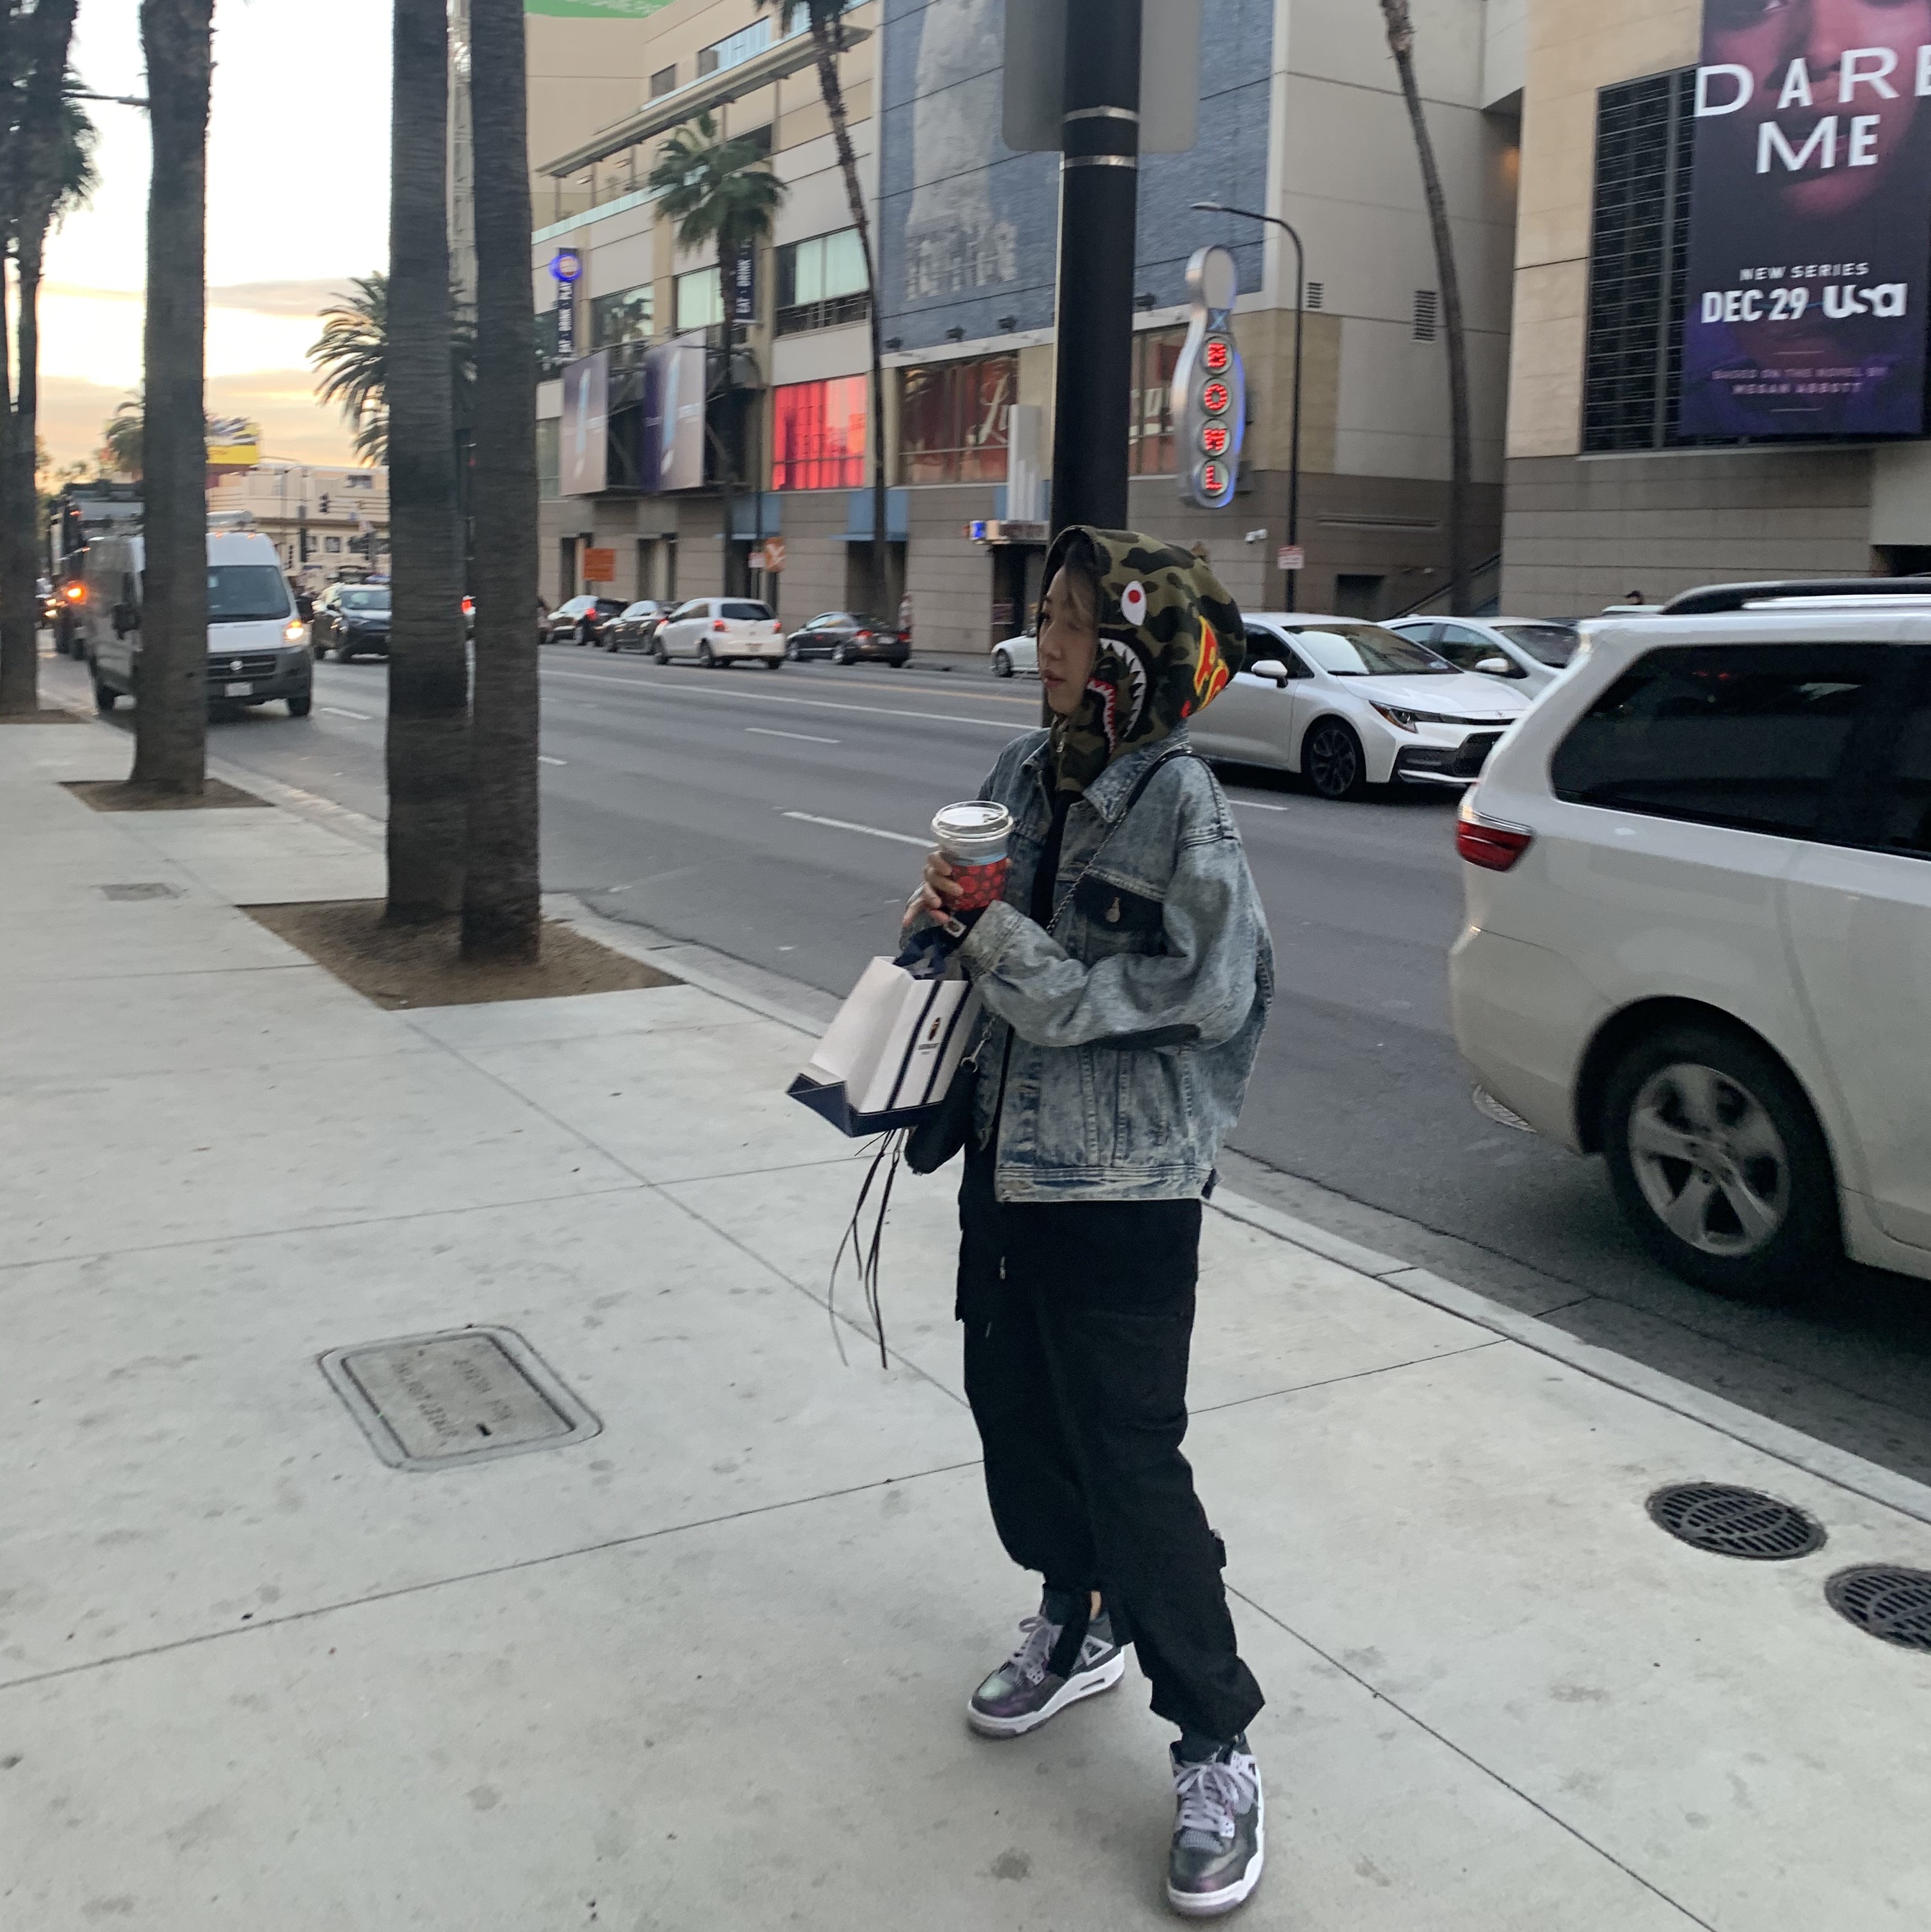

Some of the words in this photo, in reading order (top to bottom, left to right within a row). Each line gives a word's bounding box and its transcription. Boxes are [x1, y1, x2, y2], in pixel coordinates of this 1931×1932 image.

[1755, 114, 1881, 174] ME
[1739, 266, 1787, 282] NEW
[1790, 262, 1870, 278] SERIES
[1700, 289, 1764, 323] DEC
[1768, 287, 1810, 321] 29
[1204, 343, 1228, 490] BOWL
